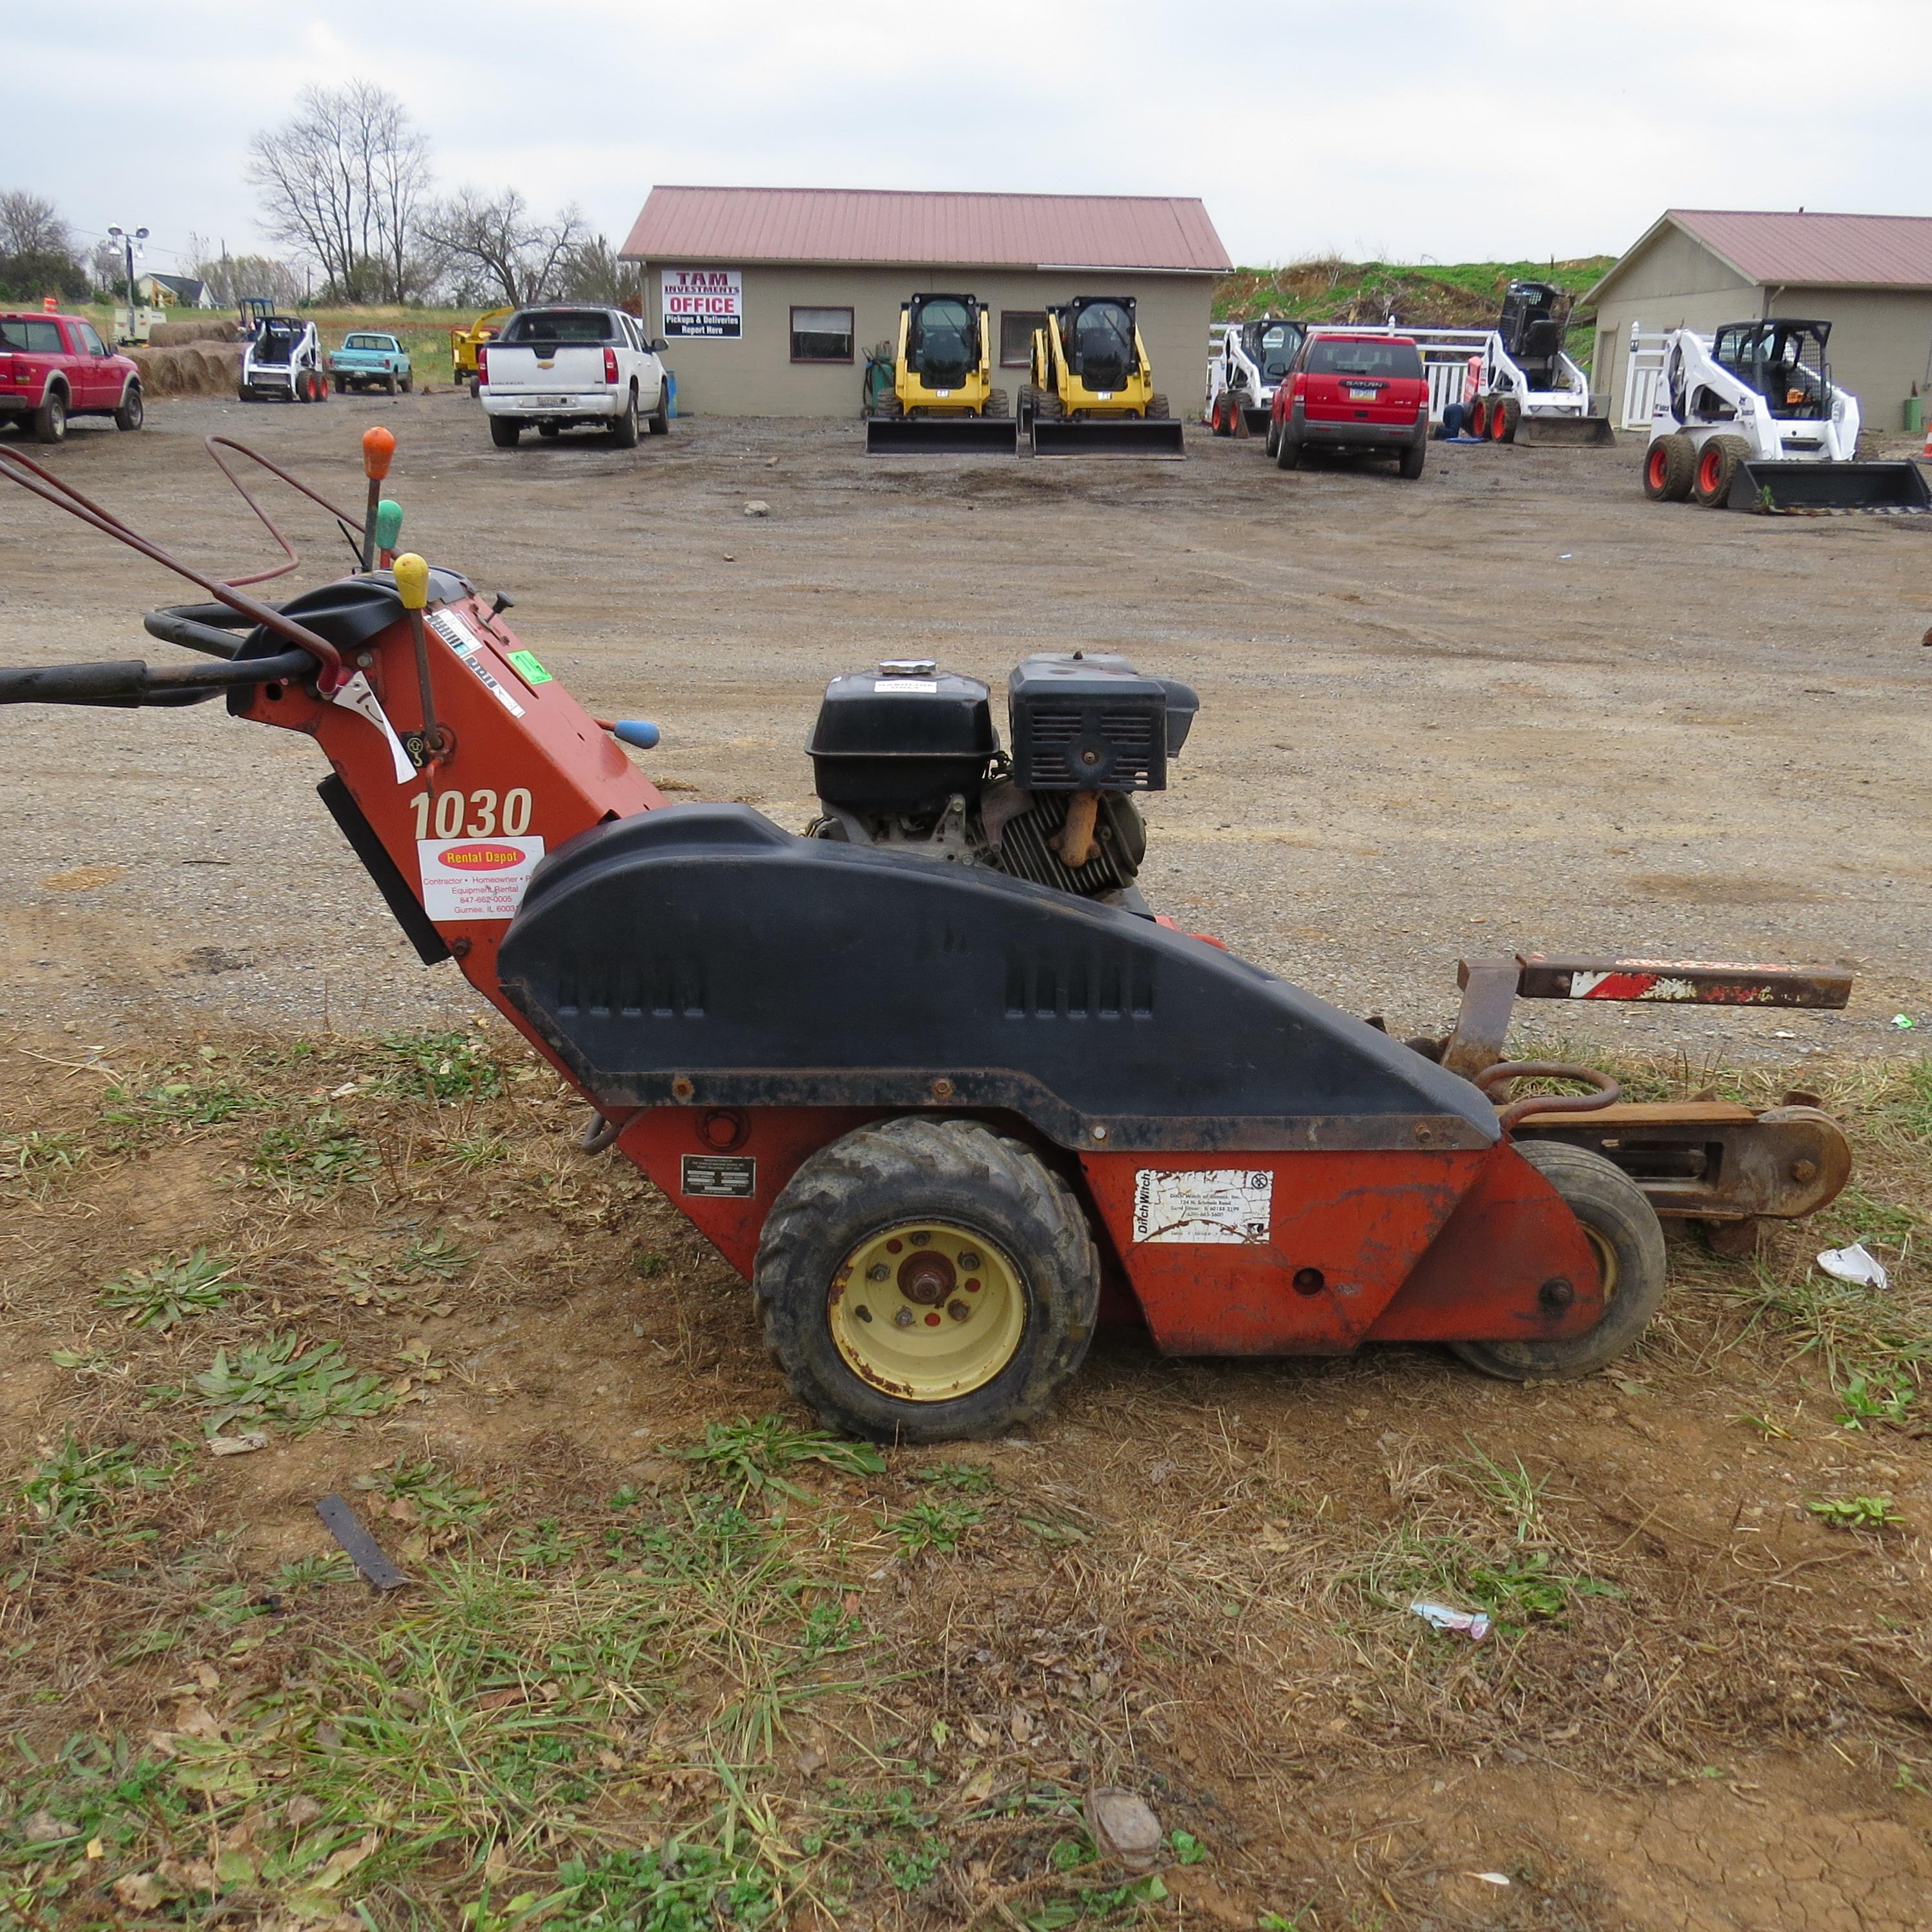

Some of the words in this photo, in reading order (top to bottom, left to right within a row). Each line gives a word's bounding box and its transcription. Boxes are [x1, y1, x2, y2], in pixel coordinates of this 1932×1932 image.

[676, 272, 728, 285] TAM
[670, 297, 734, 313] OFFICE
[666, 315, 694, 325] Pickups
[703, 316, 738, 325] Deliveries
[682, 325, 705, 335] Report
[410, 788, 532, 839] 1030
[447, 852, 482, 863] Rental
[486, 851, 517, 864] Depot
[460, 895, 512, 903] 847-662-0005
[1140, 1173, 1150, 1204] Witch
[1138, 1204, 1149, 1234] Ditch
